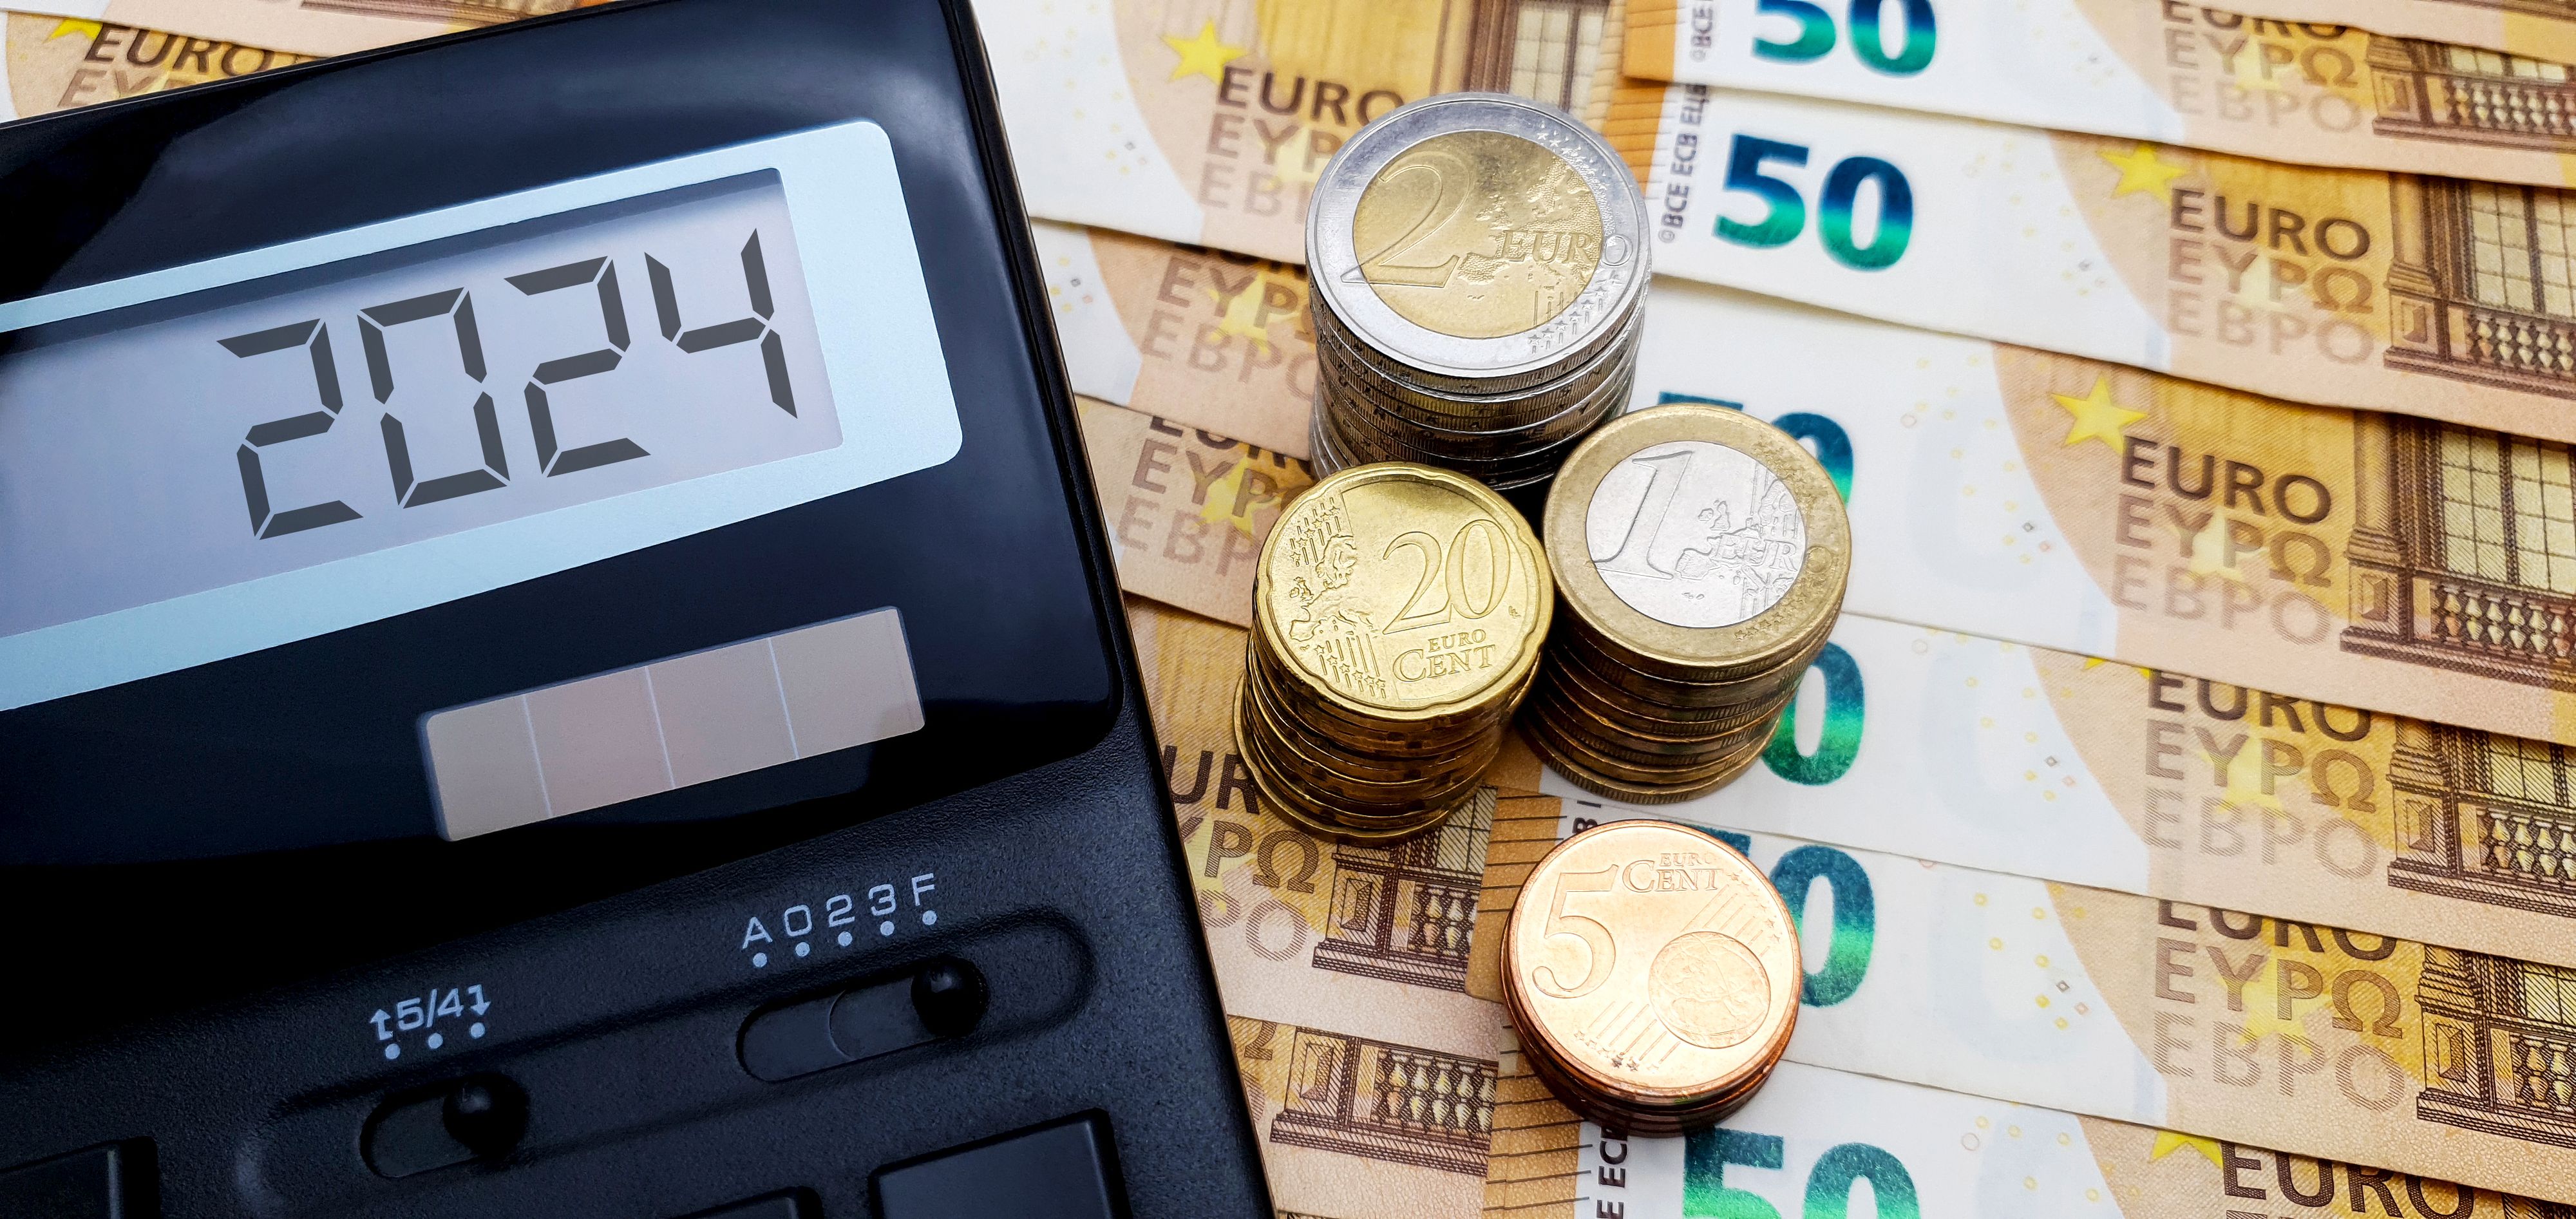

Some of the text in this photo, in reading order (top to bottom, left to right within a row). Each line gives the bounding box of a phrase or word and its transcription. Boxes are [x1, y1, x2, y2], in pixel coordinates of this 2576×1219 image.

[1751, 0, 1937, 77] 50
[1217, 66, 1405, 128] EURO
[1669, 132, 1698, 176] ECB
[1340, 151, 1471, 288] 2
[1501, 229, 1633, 267] EURO
[1712, 133, 1913, 273] 50
[2170, 187, 2371, 261] EURO
[216, 227, 798, 540] 2024
[1591, 450, 1693, 580] 1
[2120, 435, 2332, 525] EURO
[1382, 519, 1511, 636] 20
[1428, 628, 1487, 653] EURO
[1531, 864, 1619, 999] 5
[2221, 1141, 2475, 1219] EURO
